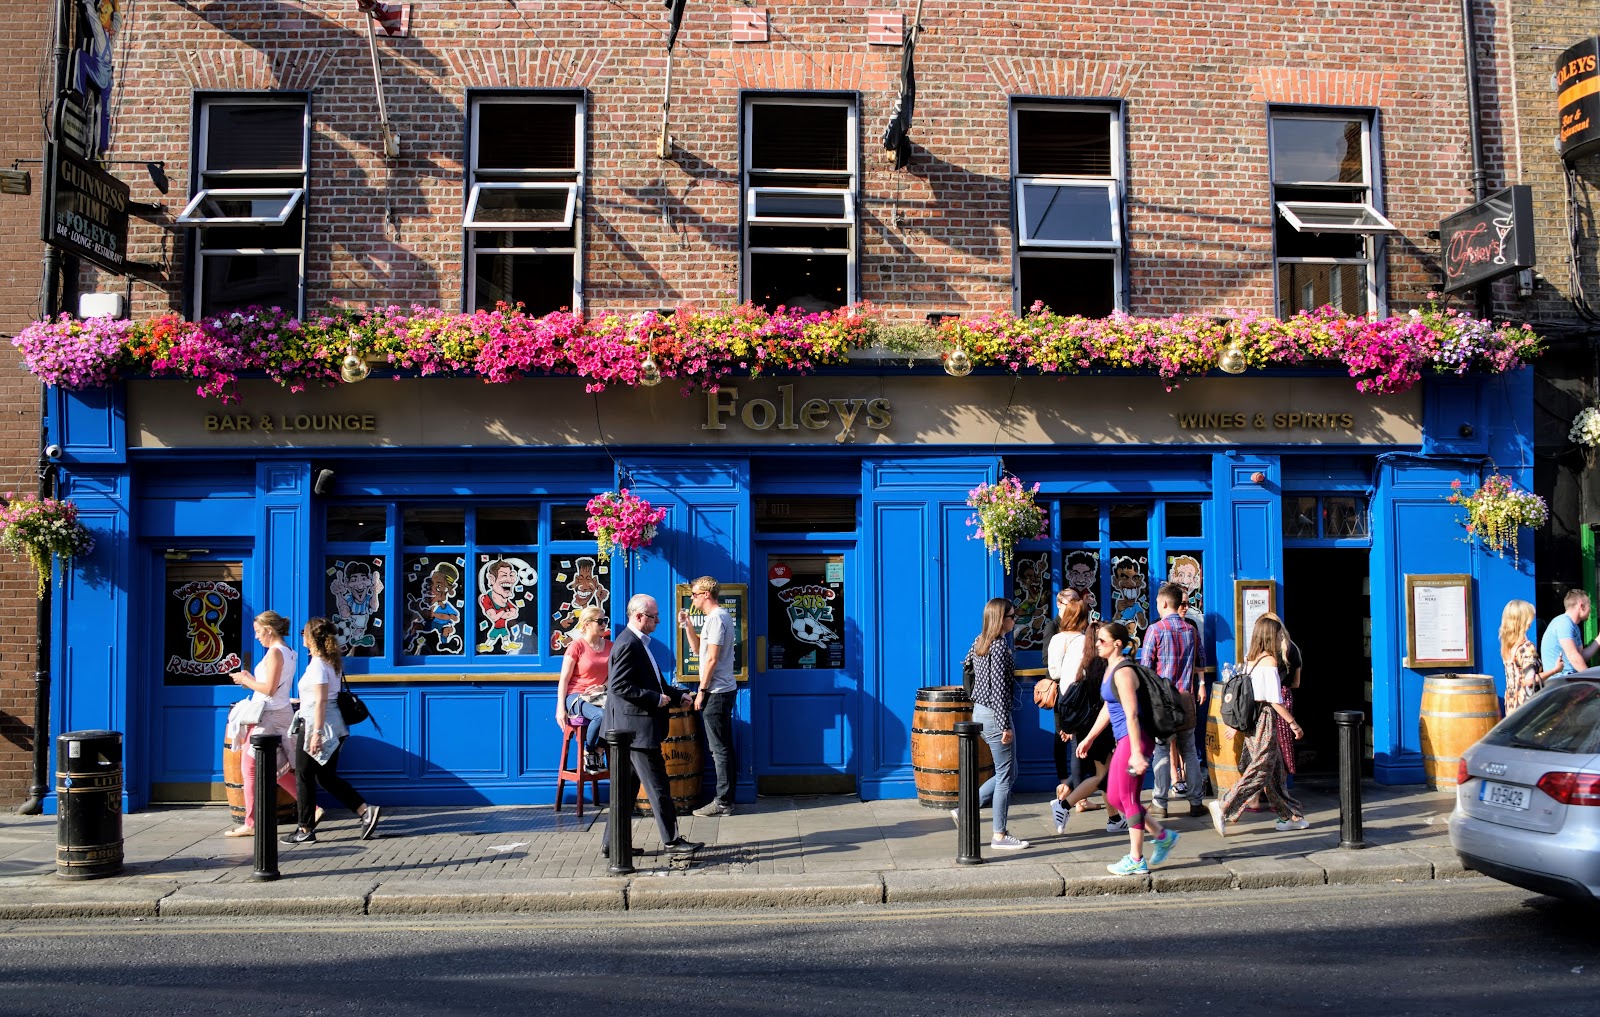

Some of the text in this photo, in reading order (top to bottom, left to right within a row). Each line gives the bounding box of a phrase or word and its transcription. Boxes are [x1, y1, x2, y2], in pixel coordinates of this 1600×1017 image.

[1557, 55, 1596, 86] OLEYS
[61, 159, 125, 213] GUINNESS
[77, 191, 109, 226] TIME
[57, 210, 117, 250] at FOLEY'S
[56, 223, 123, 265] BAR LOUNGE RESTAURANT
[204, 414, 375, 431] BAR & LOUNGE
[701, 384, 892, 443] Foleys
[1178, 412, 1354, 428] WINES & SPIRITS
[173, 581, 240, 600] WORLD CUP
[792, 595, 825, 609] 2018
[689, 615, 706, 627] MUS
[166, 655, 218, 676] RUSSIA
[94, 775, 122, 787] LITT
